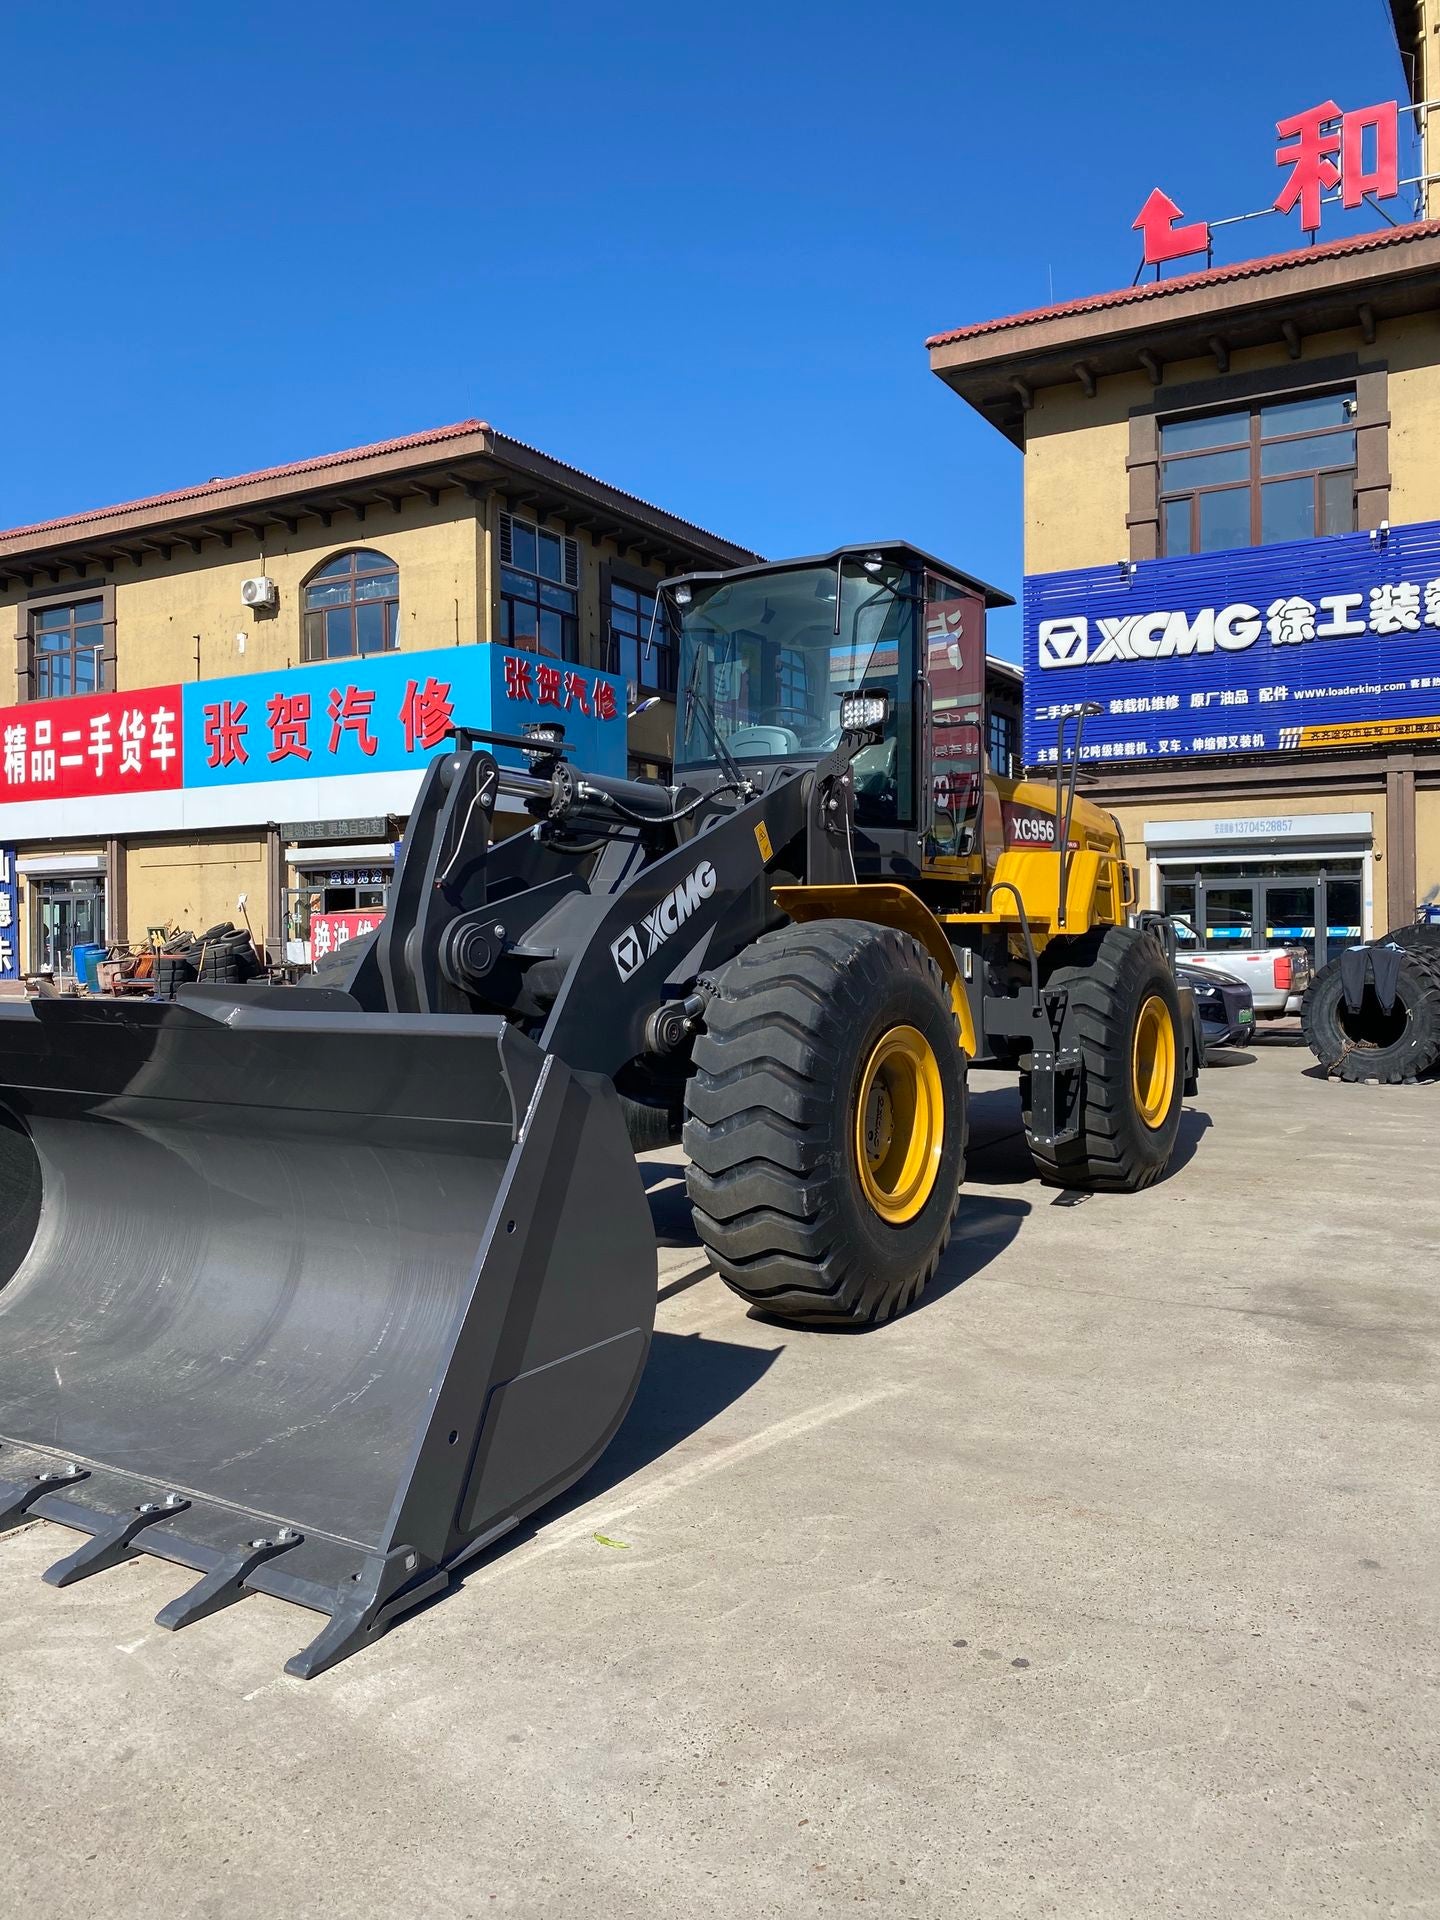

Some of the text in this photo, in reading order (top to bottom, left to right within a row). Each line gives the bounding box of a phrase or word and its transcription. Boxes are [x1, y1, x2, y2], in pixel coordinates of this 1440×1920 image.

[1273, 99, 1398, 231] 和
[1087, 603, 1262, 664] XCMG
[203, 677, 457, 768] 张贺汽修
[504, 655, 618, 720] 张贺汽修
[1110, 694, 1180, 715] 装载机维修
[1190, 689, 1249, 708] 原厂油品
[1259, 685, 1289, 702] 配件
[4, 705, 176, 785] 精品二手货车
[1012, 817, 1055, 842] XC956
[640, 860, 717, 960] XCMG
